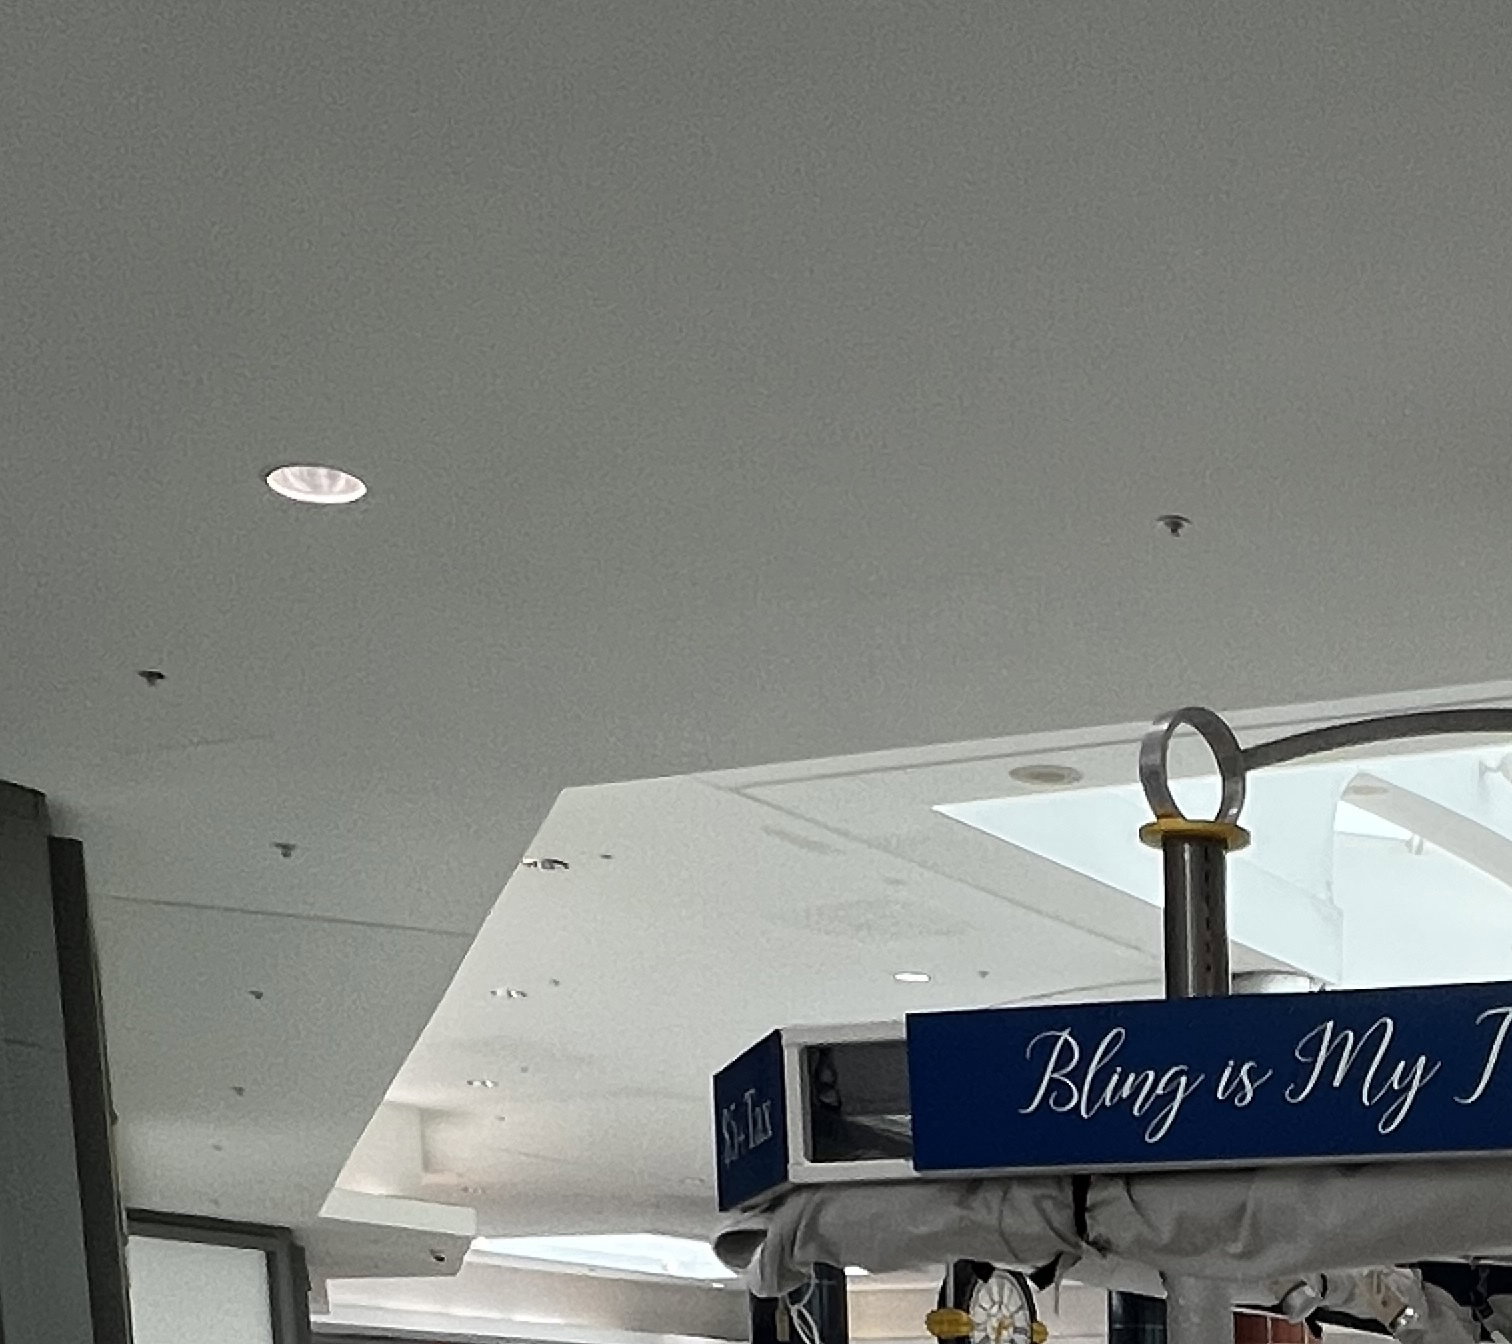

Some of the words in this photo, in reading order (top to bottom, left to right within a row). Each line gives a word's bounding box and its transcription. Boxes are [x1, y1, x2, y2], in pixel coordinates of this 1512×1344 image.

[1018, 1026, 1206, 1144] Bling
[1216, 1059, 1274, 1108] is
[1284, 1015, 1442, 1134] My
